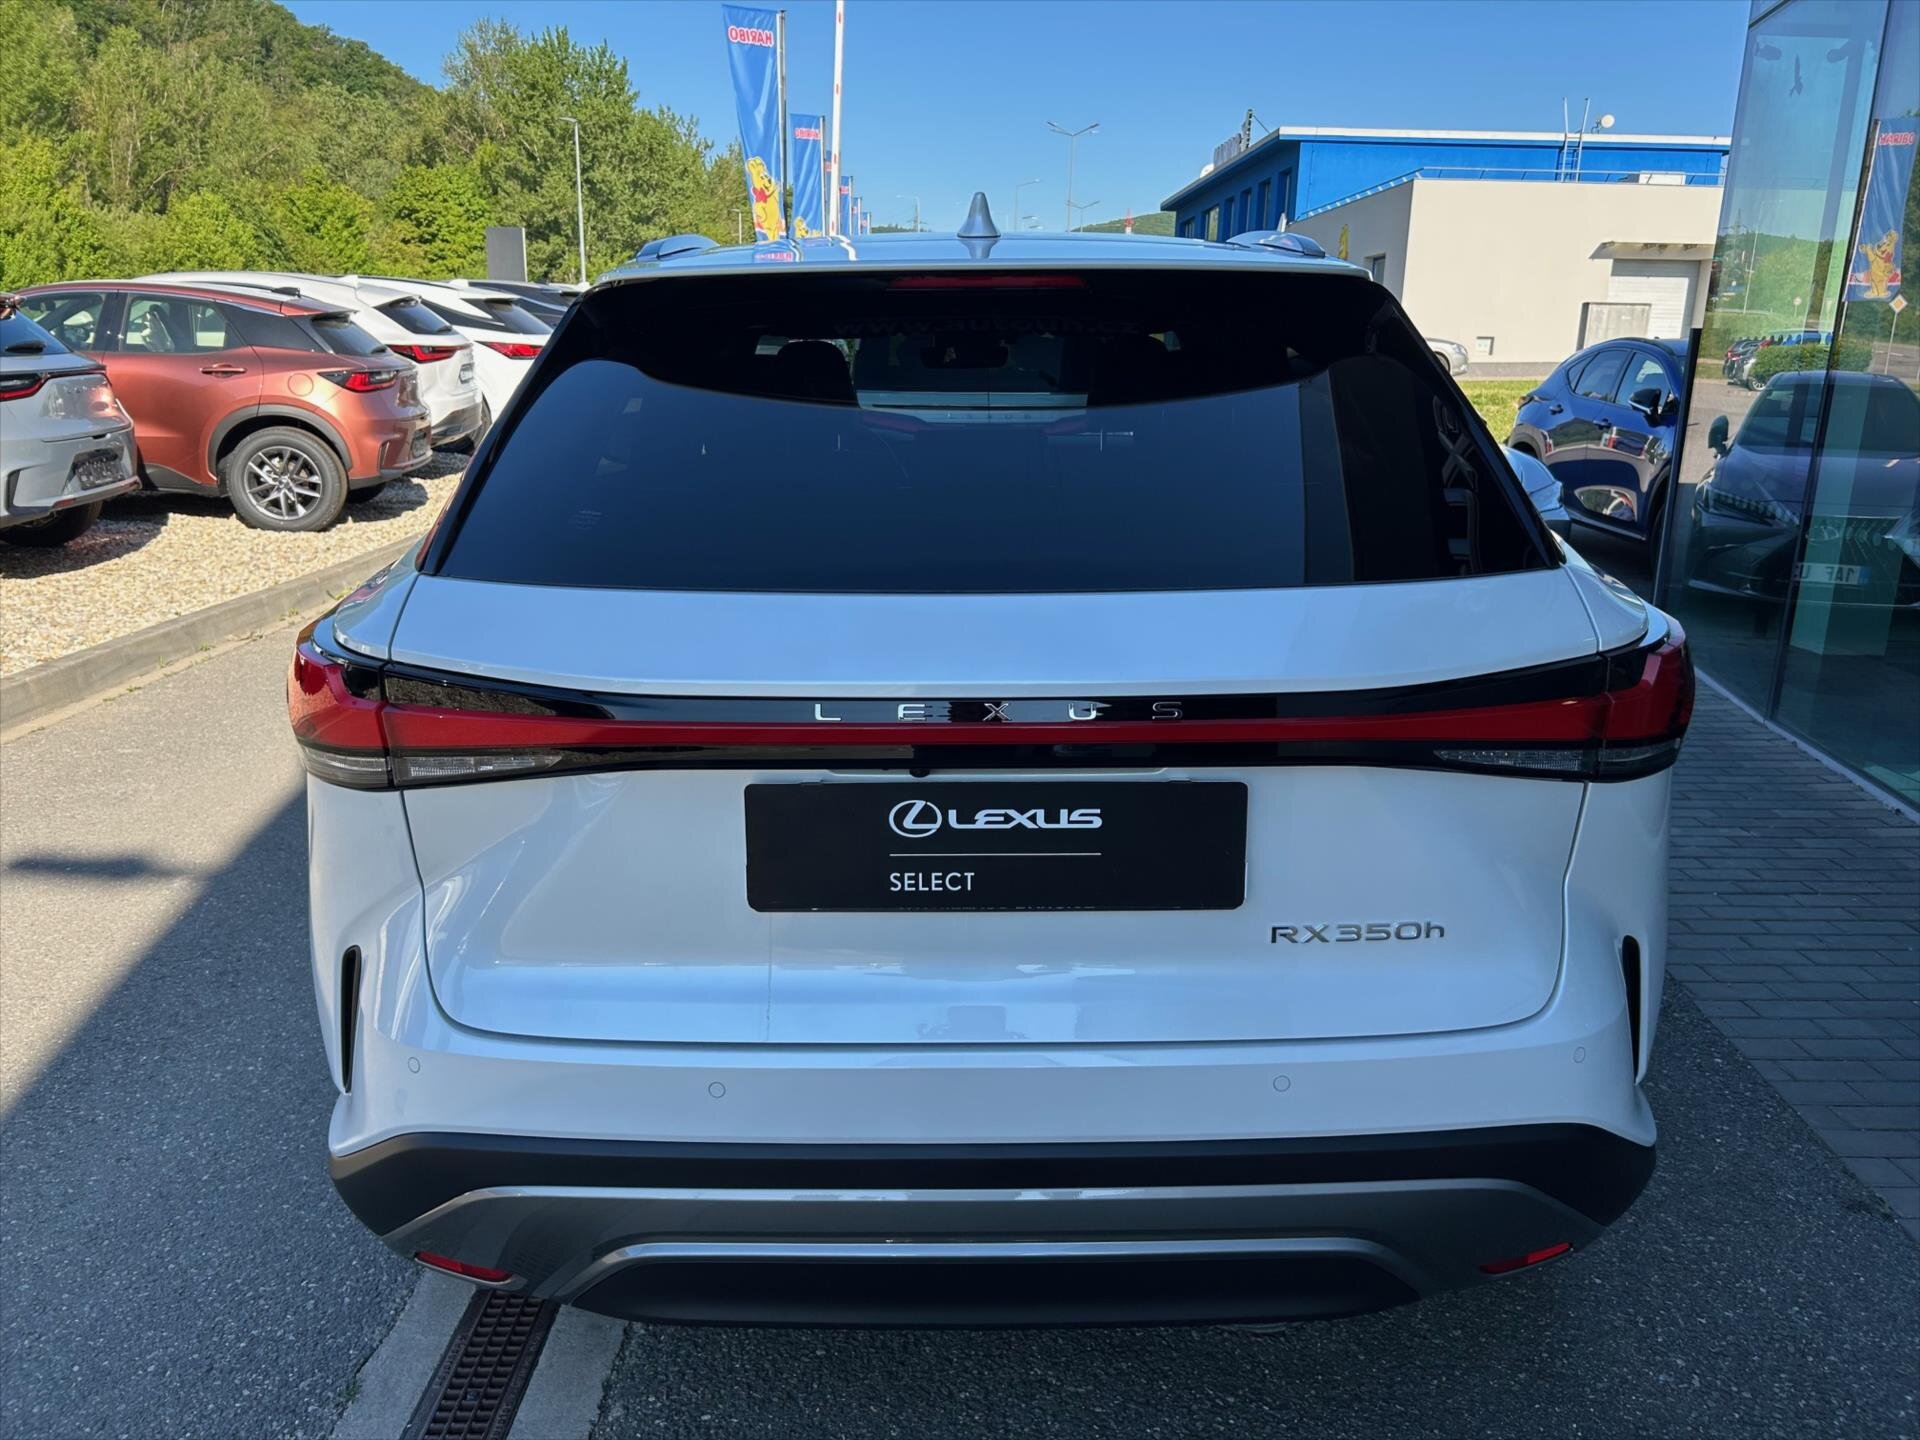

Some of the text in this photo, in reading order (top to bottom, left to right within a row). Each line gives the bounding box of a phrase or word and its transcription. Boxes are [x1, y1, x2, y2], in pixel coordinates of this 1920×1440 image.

[814, 702, 1182, 721] LEXUS
[948, 809, 1102, 829] LEXUS
[890, 872, 975, 891] SELECT
[1271, 921, 1445, 944] RX350h
